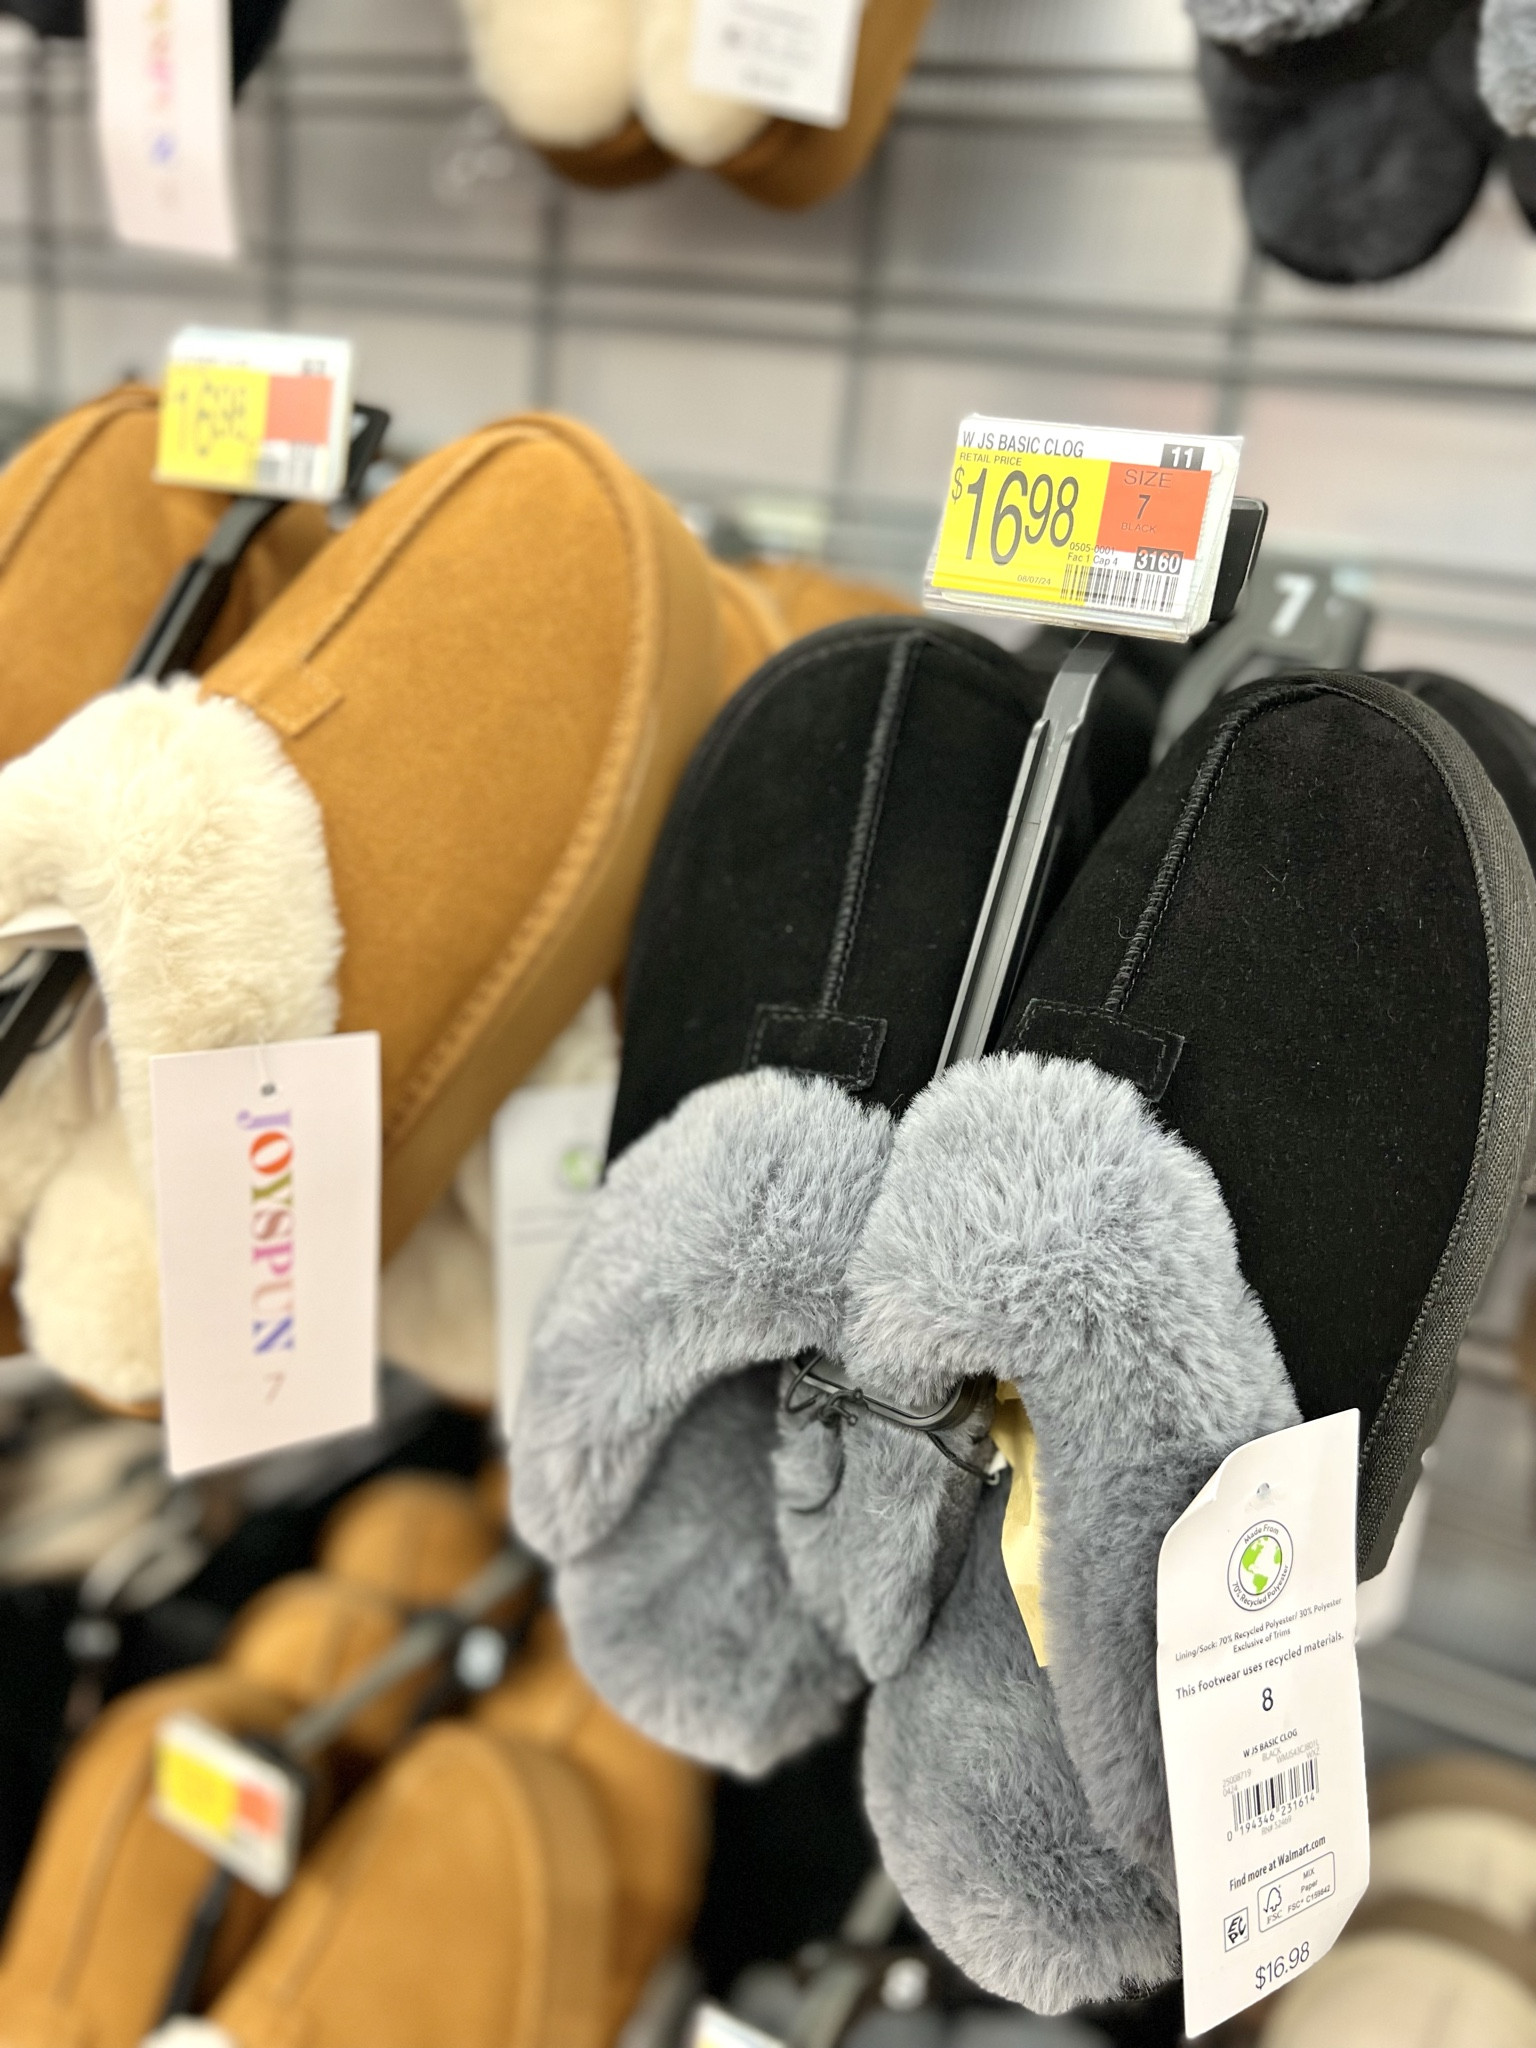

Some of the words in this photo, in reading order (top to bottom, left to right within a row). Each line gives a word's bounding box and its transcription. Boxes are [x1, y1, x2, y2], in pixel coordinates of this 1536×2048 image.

[962, 431, 976, 447] W
[977, 433, 994, 450] JS
[998, 435, 1040, 454] BASIC
[1043, 438, 1084, 459] CLOG
[959, 452, 991, 465] RETAIL
[993, 455, 1022, 467] PRICE
[1170, 447, 1194, 469] 11
[1123, 468, 1174, 490] SIZE
[1136, 494, 1152, 520] 7
[1120, 521, 1157, 534] BLACK
[1067, 552, 1083, 563] Fac
[1085, 553, 1091, 564] 1
[1092, 555, 1110, 567] Cap
[1111, 556, 1119, 567] 4
[1069, 541, 1116, 556] 0505-0001
[1135, 549, 1181, 574] 3160
[1016, 574, 1052, 586] 08/07/24
[1270, 572, 1316, 637] 7
[236, 1109, 295, 1356] JOYSPUN
[1243, 1527, 1262, 1544] Made
[1263, 1523, 1279, 1535] From
[1232, 1581, 1242, 1598] 70%
[1240, 1593, 1267, 1607] Recycled
[1267, 1565, 1289, 1600] Polyester
[1175, 1641, 1218, 1662] Lining/Sock:
[1219, 1635, 1233, 1646] 70%
[1234, 1624, 1264, 1641] Recycled
[1265, 1612, 1298, 1630] Polyester/
[1299, 1607, 1313, 1619] 30%
[1313, 1598, 1342, 1613] Polyester
[1233, 1638, 1264, 1653] Exclusive
[1265, 1634, 1273, 1643] of
[1273, 1628, 1291, 1640] Trims
[1176, 1685, 1196, 1700] This
[1198, 1669, 1241, 1692] footwear
[1243, 1663, 1263, 1676] uses
[1265, 1645, 1302, 1669] recycled
[1304, 1630, 1345, 1654] materials.
[1262, 1687, 1274, 1711] 8
[1243, 1749, 1250, 1758] W
[1251, 1745, 1259, 1755] JS
[1259, 1736, 1279, 1752] BASIC
[1279, 1728, 1298, 1742] CLOG
[1226, 1830, 1233, 1842] 0
[1240, 1811, 1275, 1835] 194346
[1281, 1793, 1315, 1816] 231614
[1229, 1875, 1246, 1891] Find
[1247, 1865, 1267, 1882] more
[1268, 1860, 1277, 1872] at
[1277, 1836, 1327, 1867] Walmart.com
[1303, 1867, 1315, 1880] MIX
[1301, 1880, 1318, 1893] Paper
[1267, 1909, 1283, 1925] FSC
[1255, 1941, 1310, 1990] $16.98
